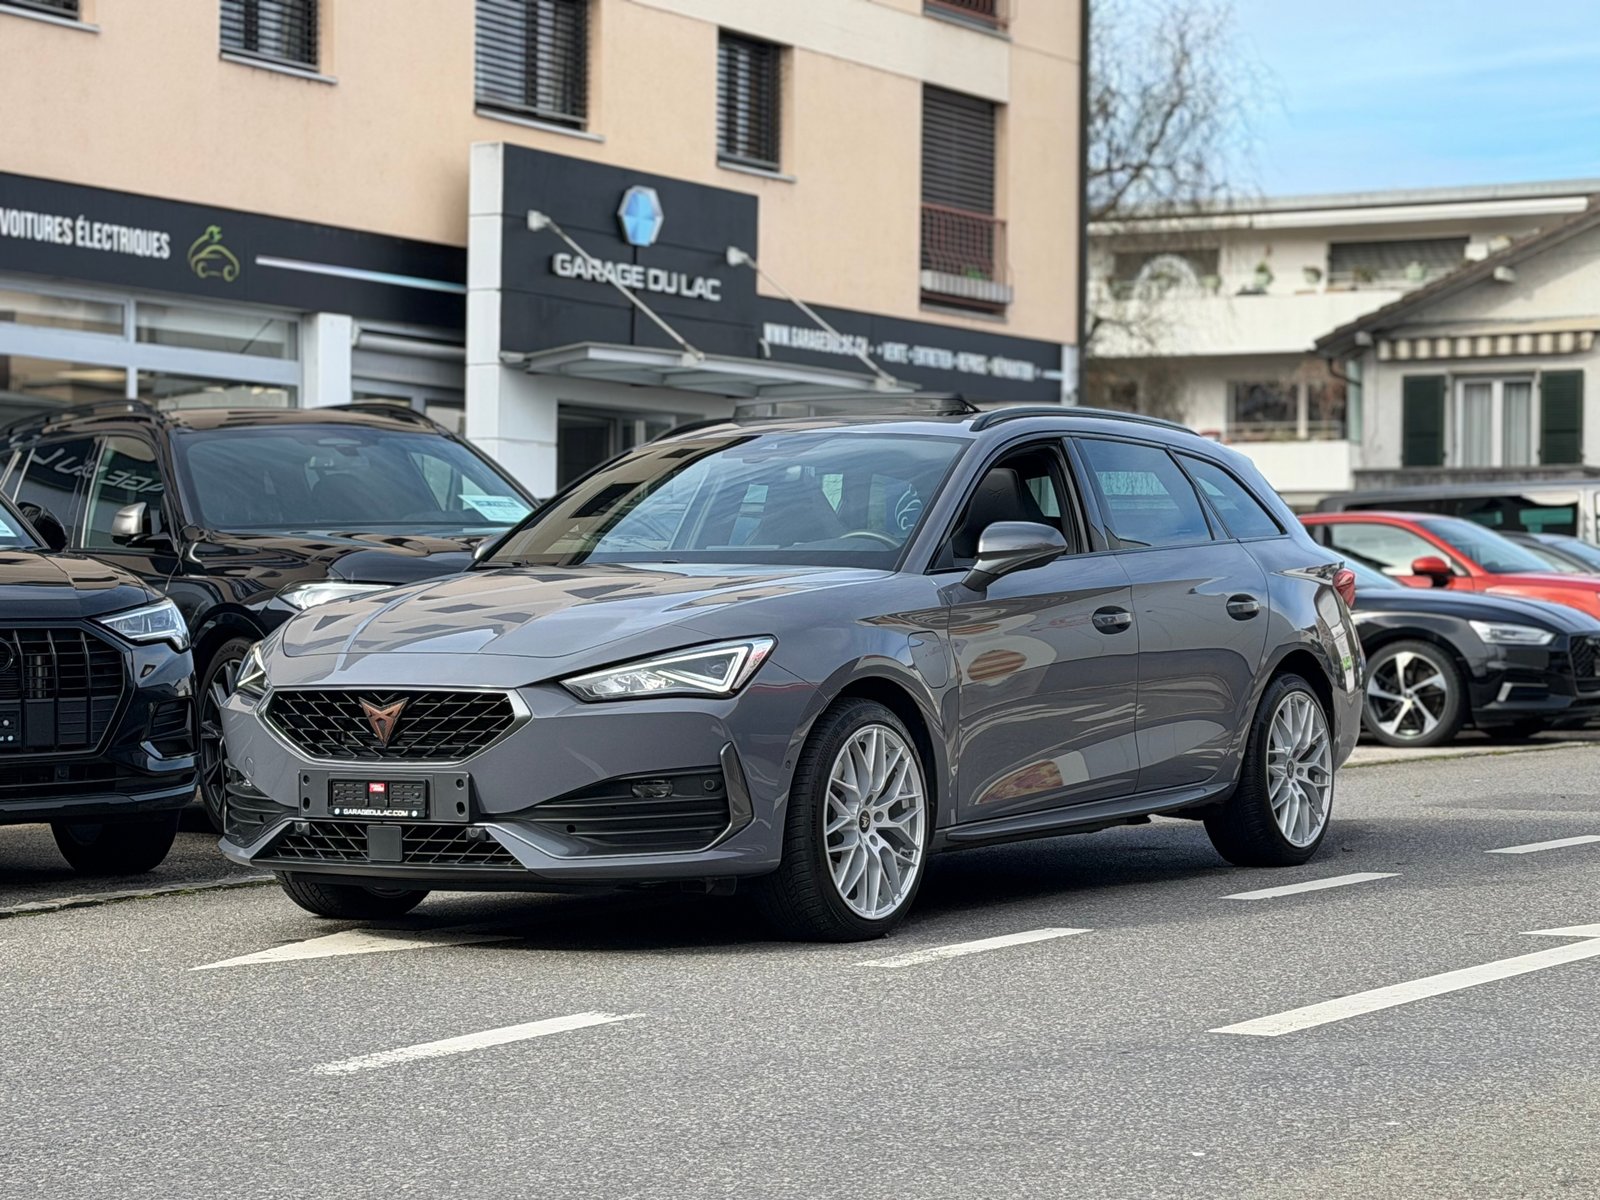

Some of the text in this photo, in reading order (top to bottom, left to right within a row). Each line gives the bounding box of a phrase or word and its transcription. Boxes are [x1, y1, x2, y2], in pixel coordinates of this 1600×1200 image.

[0, 207, 171, 260] VOITURES ÉLECTRIQUES
[551, 252, 722, 302] GARAGE DU LAC
